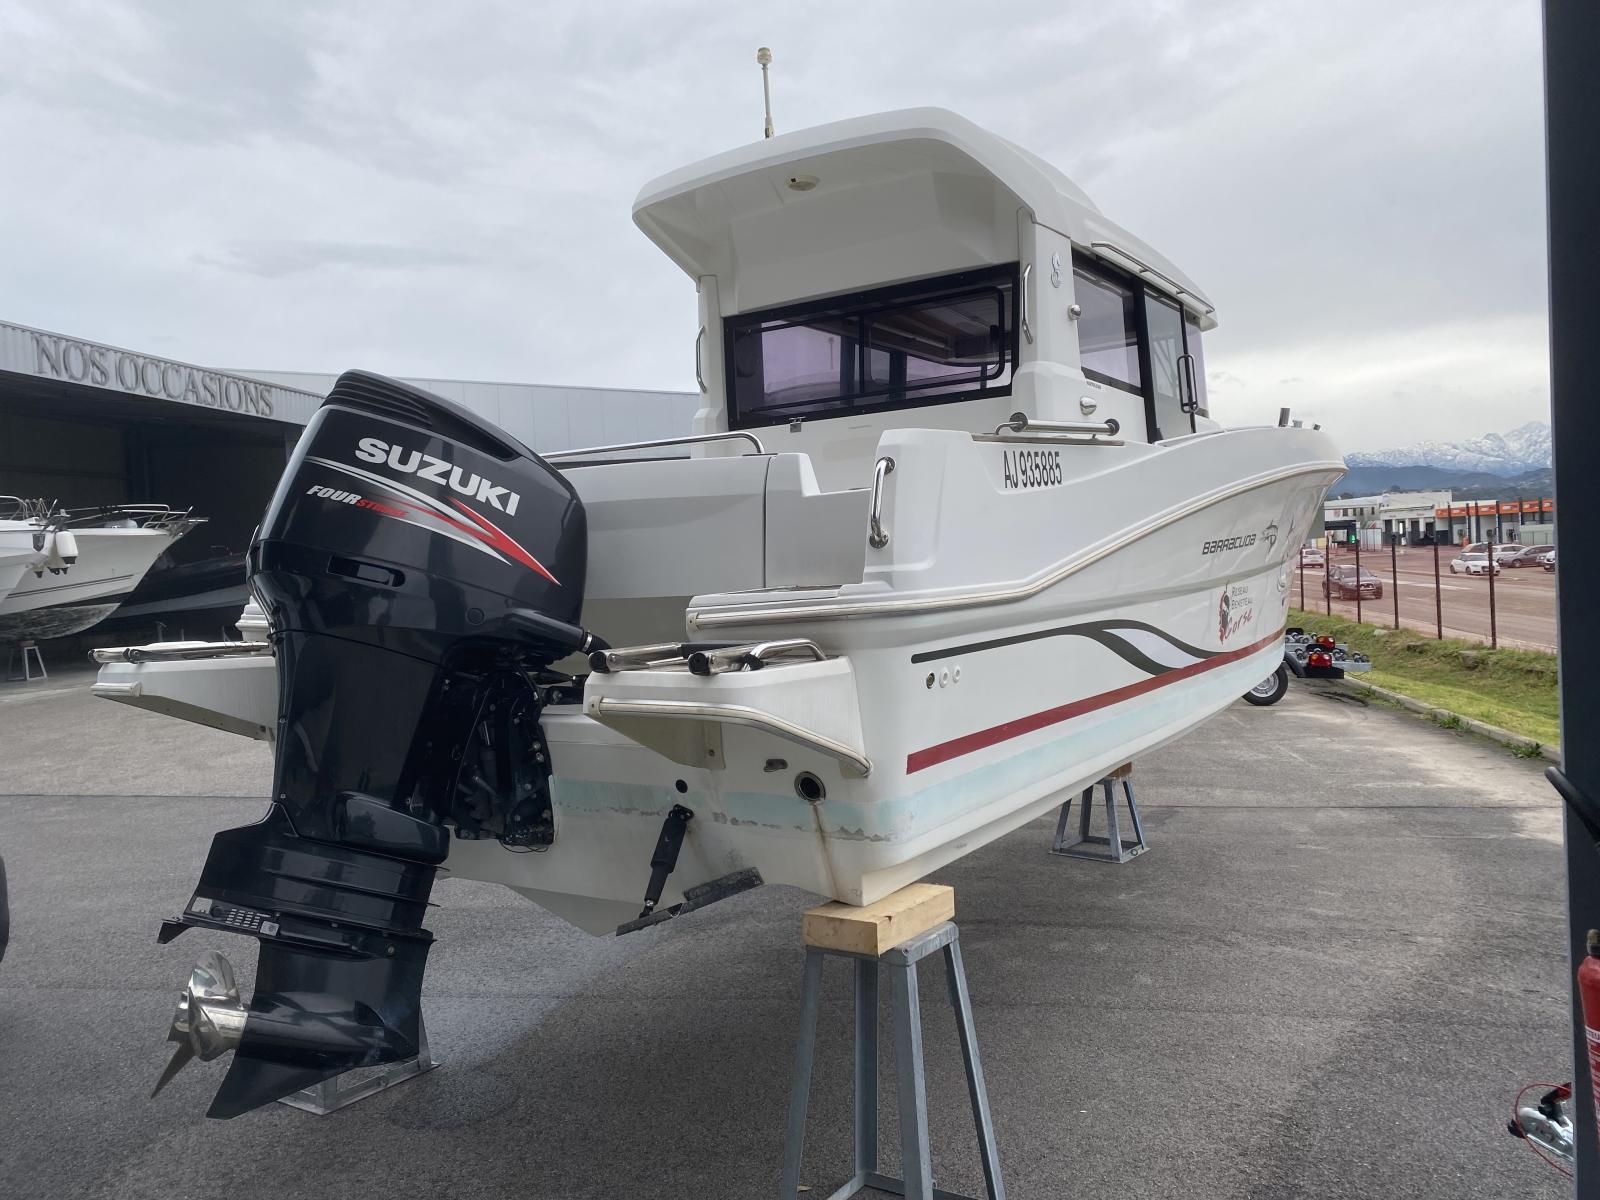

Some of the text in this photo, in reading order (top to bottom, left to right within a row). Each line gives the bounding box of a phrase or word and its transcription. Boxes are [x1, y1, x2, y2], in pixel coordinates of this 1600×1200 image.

[31, 335, 275, 418] NOS OCCASIONS
[306, 484, 410, 518] FOURSTE
[354, 437, 521, 517] SUZUKI
